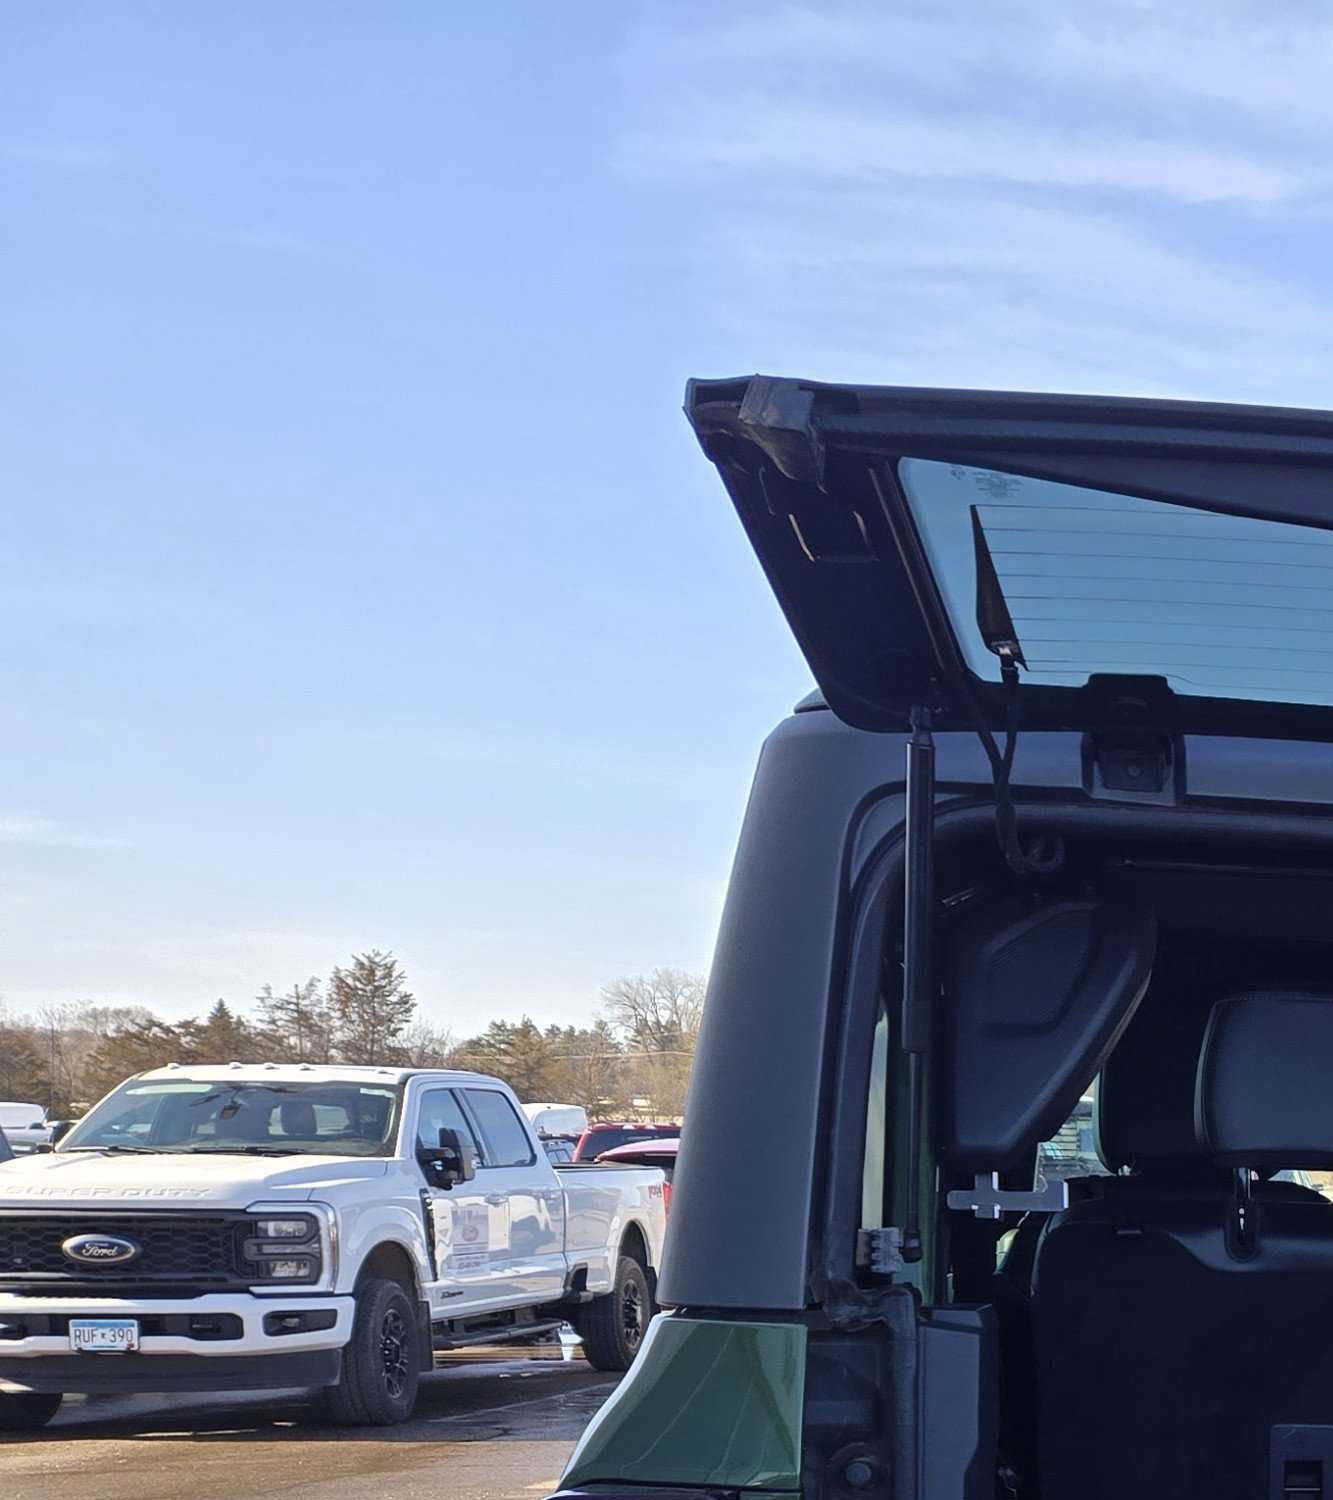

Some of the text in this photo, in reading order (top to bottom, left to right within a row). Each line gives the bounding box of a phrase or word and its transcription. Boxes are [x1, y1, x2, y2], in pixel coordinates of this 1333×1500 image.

[121, 1186, 213, 1197] DUTY
[81, 1242, 119, 1257] Ford
[74, 1327, 134, 1344] RUF 390
